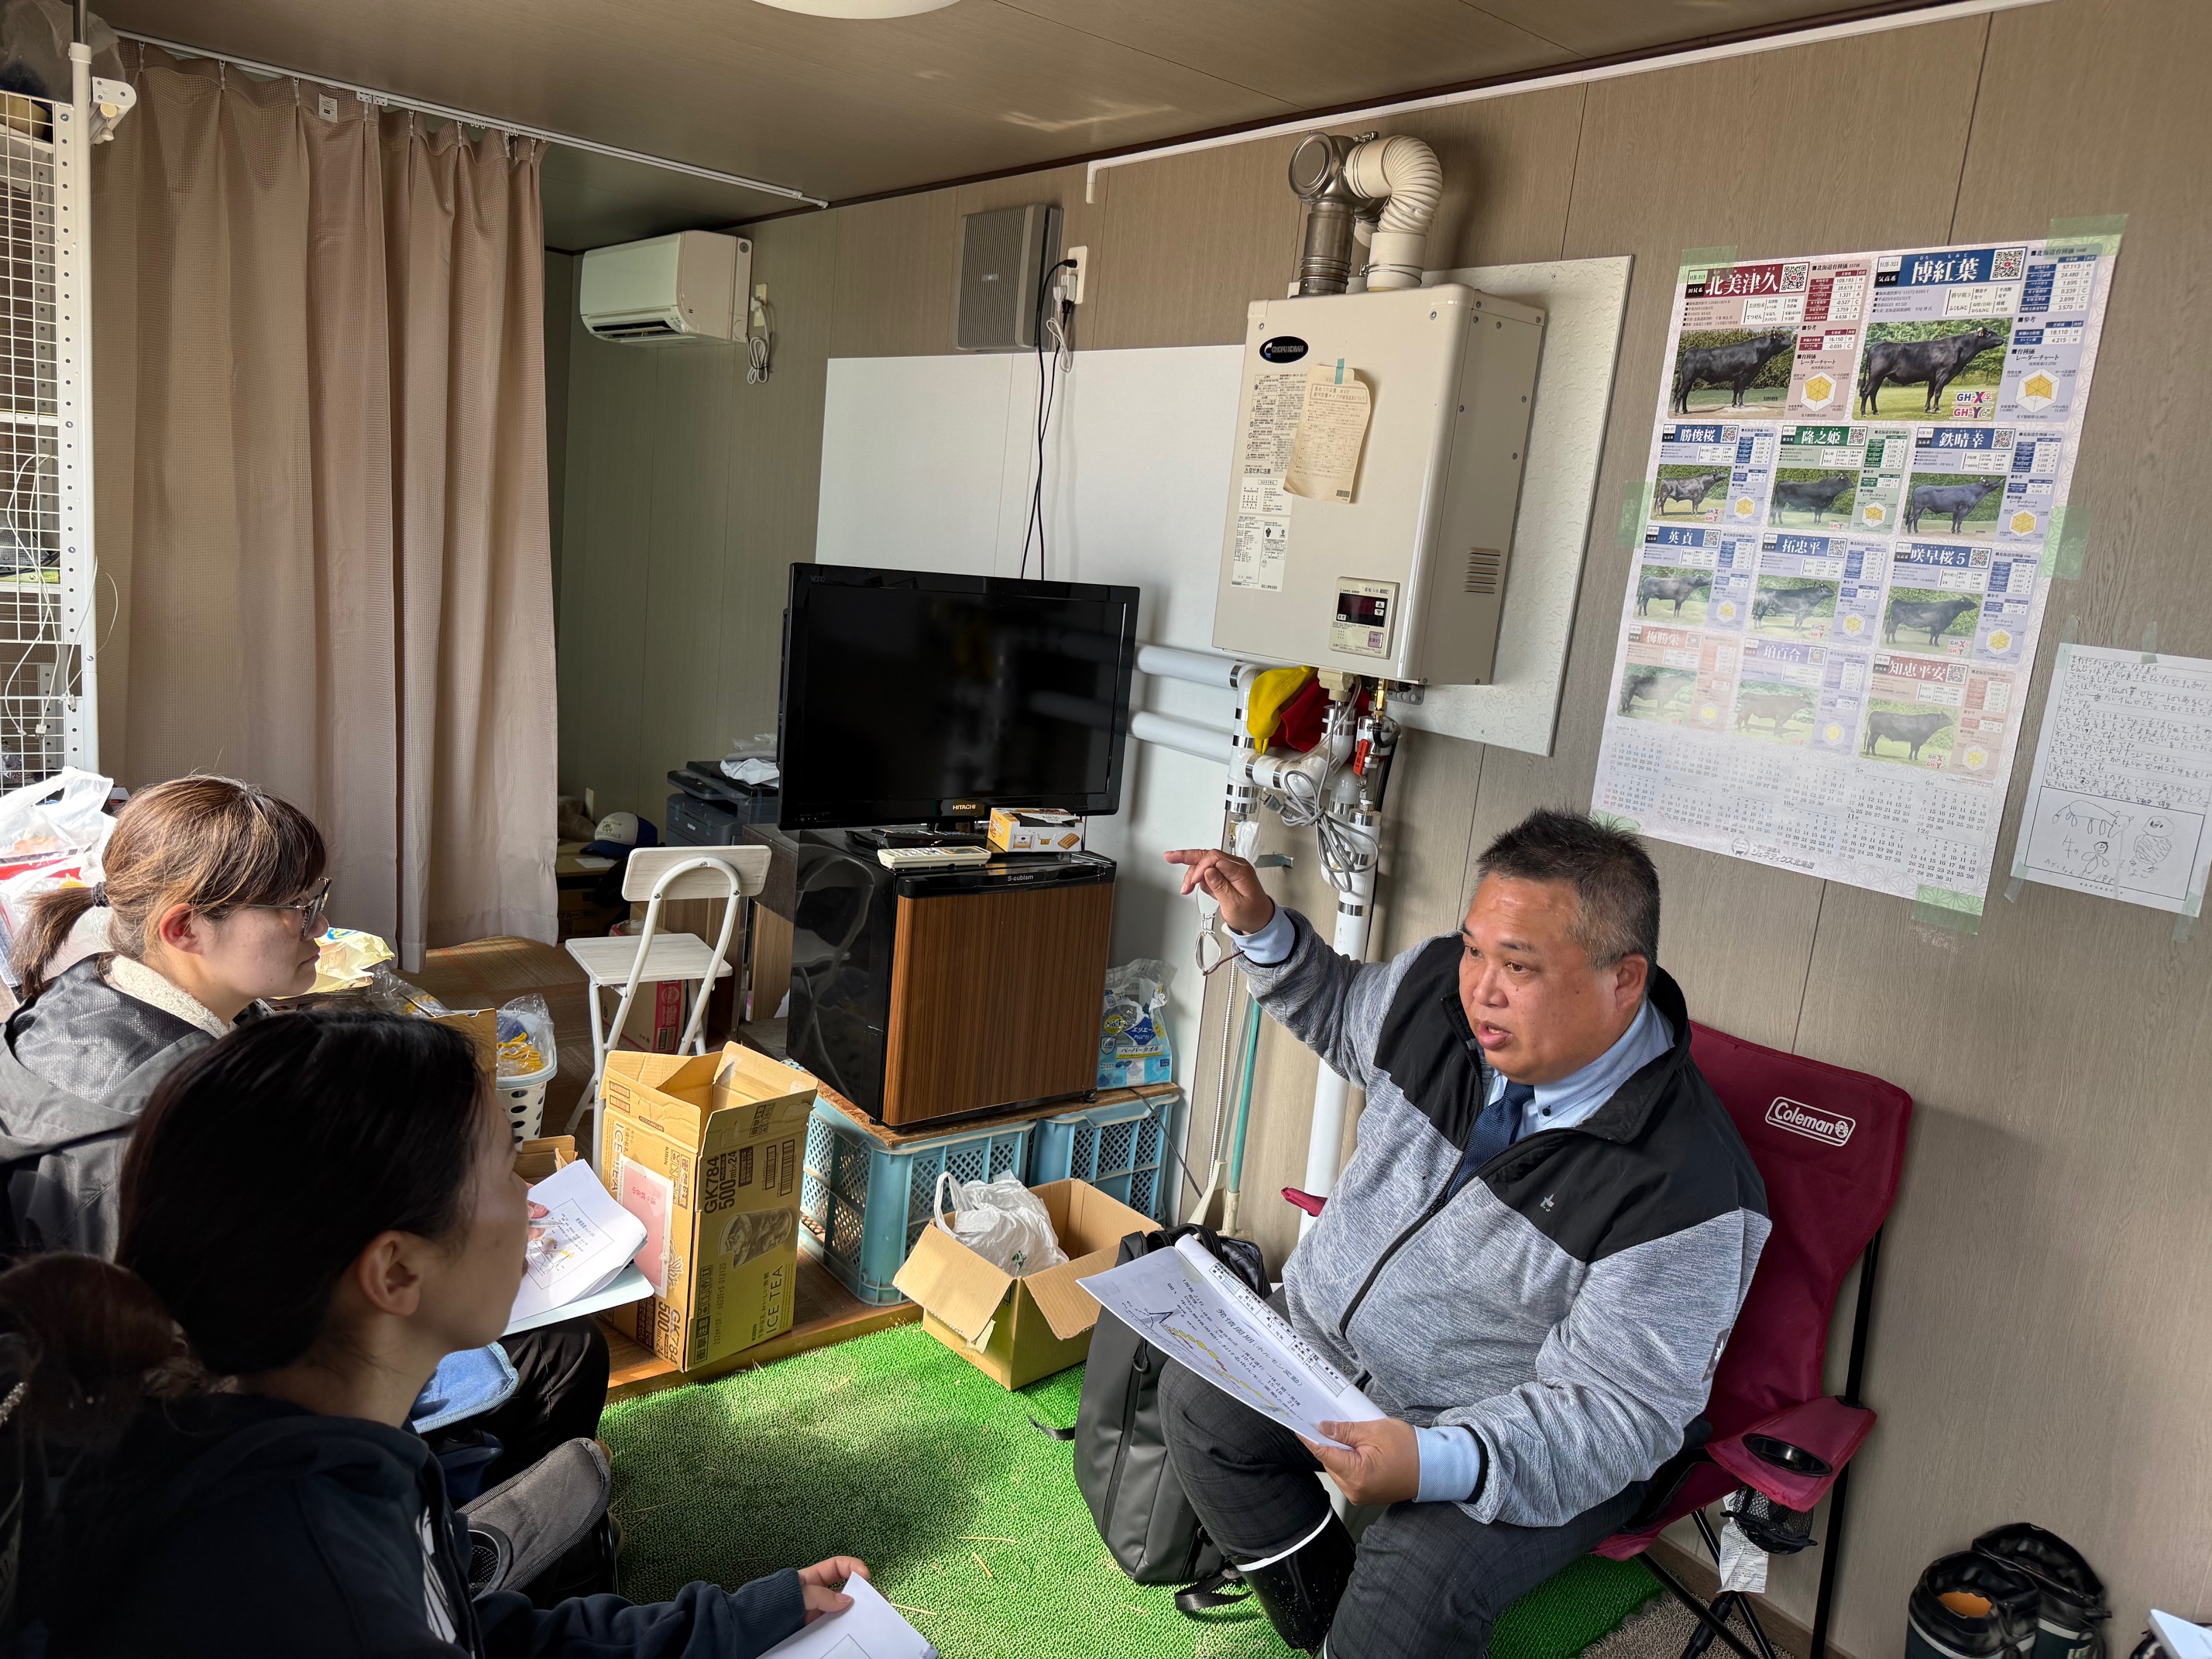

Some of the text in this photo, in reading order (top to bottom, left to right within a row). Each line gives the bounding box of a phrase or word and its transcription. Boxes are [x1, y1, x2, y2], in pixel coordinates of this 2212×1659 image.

[1911, 258, 1980, 284] 博紅葉
[1705, 271, 1779, 296] 北美津久
[1956, 391, 1985, 404] GH-X
[1953, 407, 1982, 418] GH-Y
[1679, 428, 1716, 443] 勝俊桜
[1802, 429, 1840, 445] 隆之姫
[1939, 431, 1985, 448] 鉄晴幸
[1668, 530, 1694, 546] 英貞
[1782, 537, 1822, 555] 拓忠平
[1888, 660, 1946, 682] 知恵平安
[1751, 849, 1815, 870] ジェネティクス北海道
[1774, 1101, 1835, 1135] Coleman
[613, 1122, 624, 1154] ICE
[704, 1156, 720, 1214] GK784
[766, 1265, 783, 1334] ICE TEA
